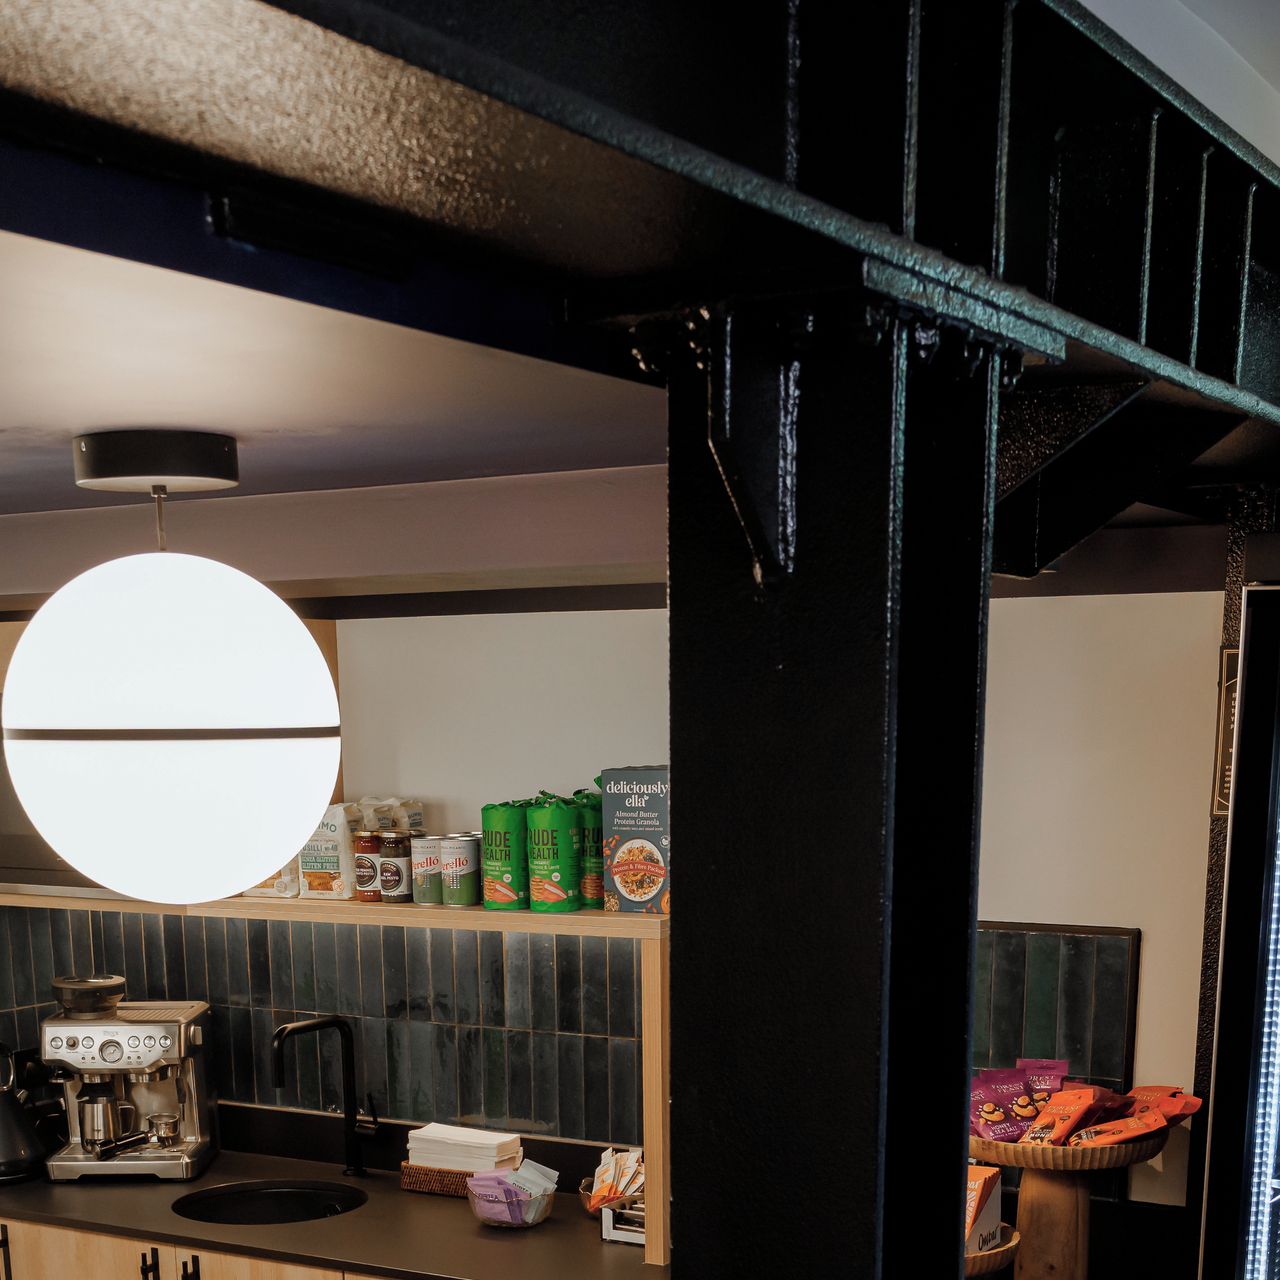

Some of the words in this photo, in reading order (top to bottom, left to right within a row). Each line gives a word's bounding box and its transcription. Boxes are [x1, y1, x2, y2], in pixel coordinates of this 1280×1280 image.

[606, 781, 669, 797] deliciously
[625, 795, 646, 807] ella
[303, 844, 323, 852] USILLI
